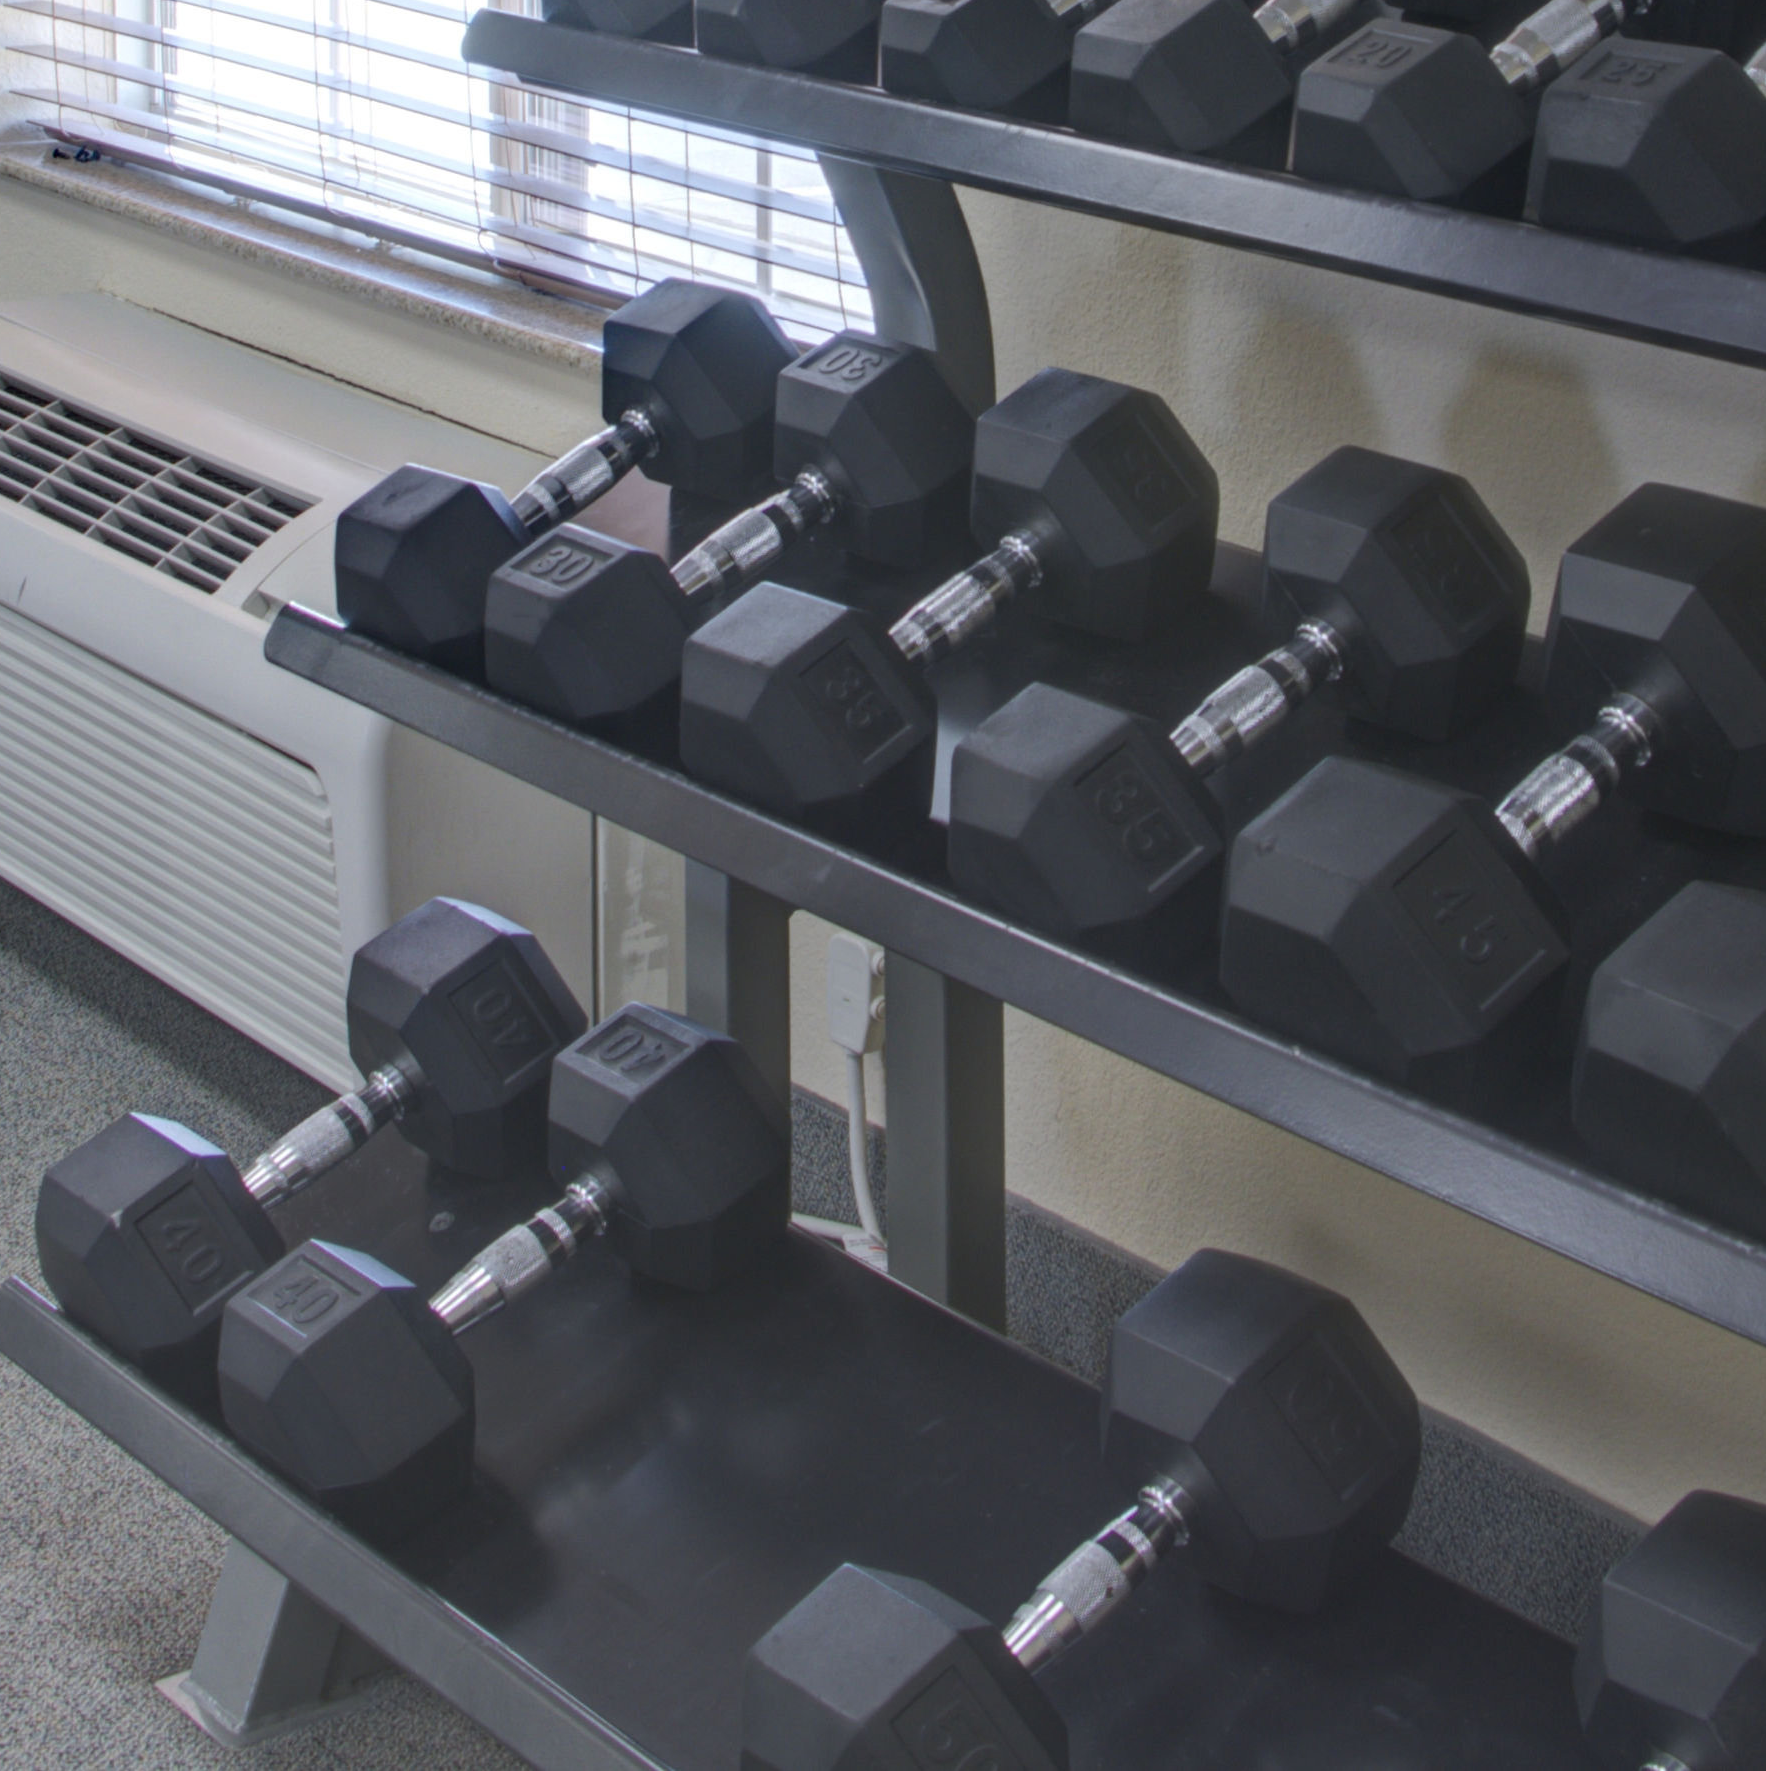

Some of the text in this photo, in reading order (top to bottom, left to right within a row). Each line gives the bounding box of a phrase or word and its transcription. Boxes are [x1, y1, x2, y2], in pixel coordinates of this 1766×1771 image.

[1348, 41, 1413, 69] 20
[1602, 61, 1666, 87] 25
[819, 343, 883, 381] 30
[528, 545, 594, 585] 30
[1094, 772, 1171, 862] 35
[1432, 885, 1508, 965] 45
[473, 988, 530, 1046] 40
[597, 1033, 667, 1073] 40
[162, 1218, 223, 1283] 40
[272, 1275, 340, 1324] 40
